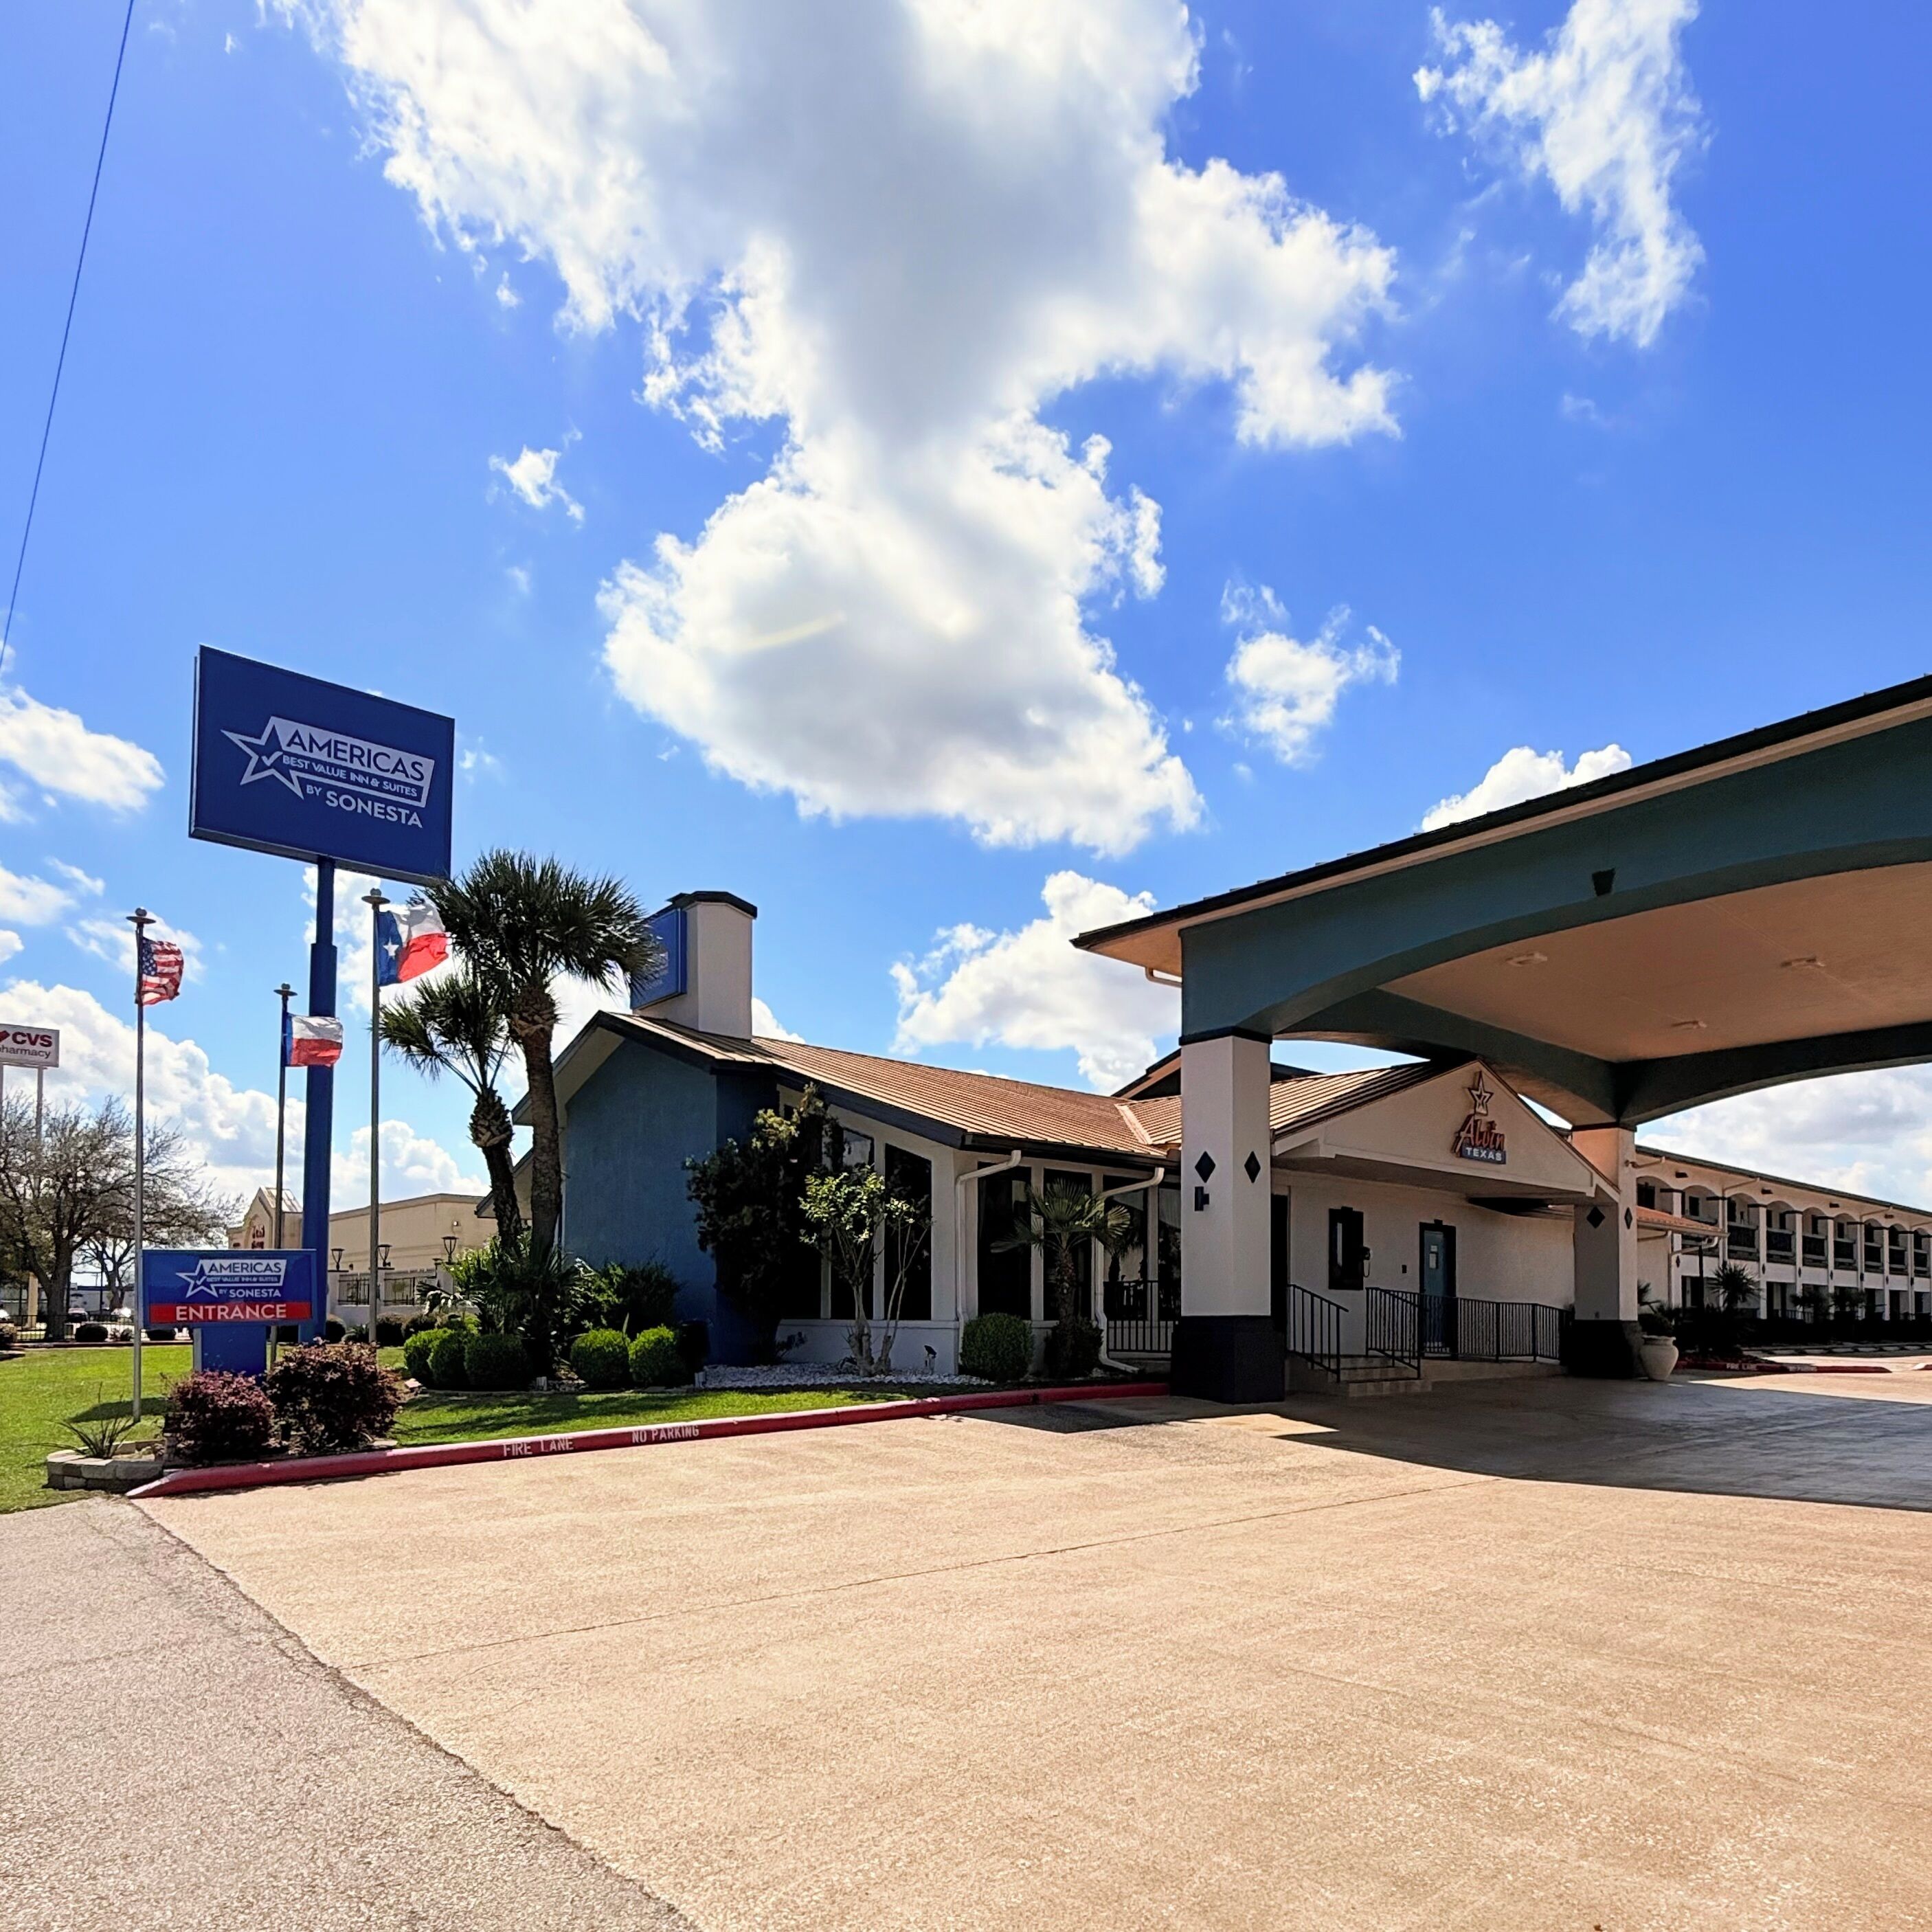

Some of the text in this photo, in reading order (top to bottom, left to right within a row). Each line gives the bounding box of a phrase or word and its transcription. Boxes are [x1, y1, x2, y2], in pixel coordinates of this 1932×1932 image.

[287, 729, 425, 782] AMERICAS
[282, 755, 311, 770] BEST
[311, 762, 347, 779] VALUE
[383, 781, 418, 797] SUITES
[306, 785, 423, 829] BY SONESTA
[12, 1031, 52, 1048] CVS
[1465, 1147, 1503, 1161] TEXAS
[208, 1262, 282, 1273] AMERICAS
[229, 1289, 282, 1298] SONESTA
[176, 1303, 287, 1321] ENTRANCE
[632, 1425, 699, 1444] NO PARKING
[503, 1437, 574, 1457] FIRE LANE
